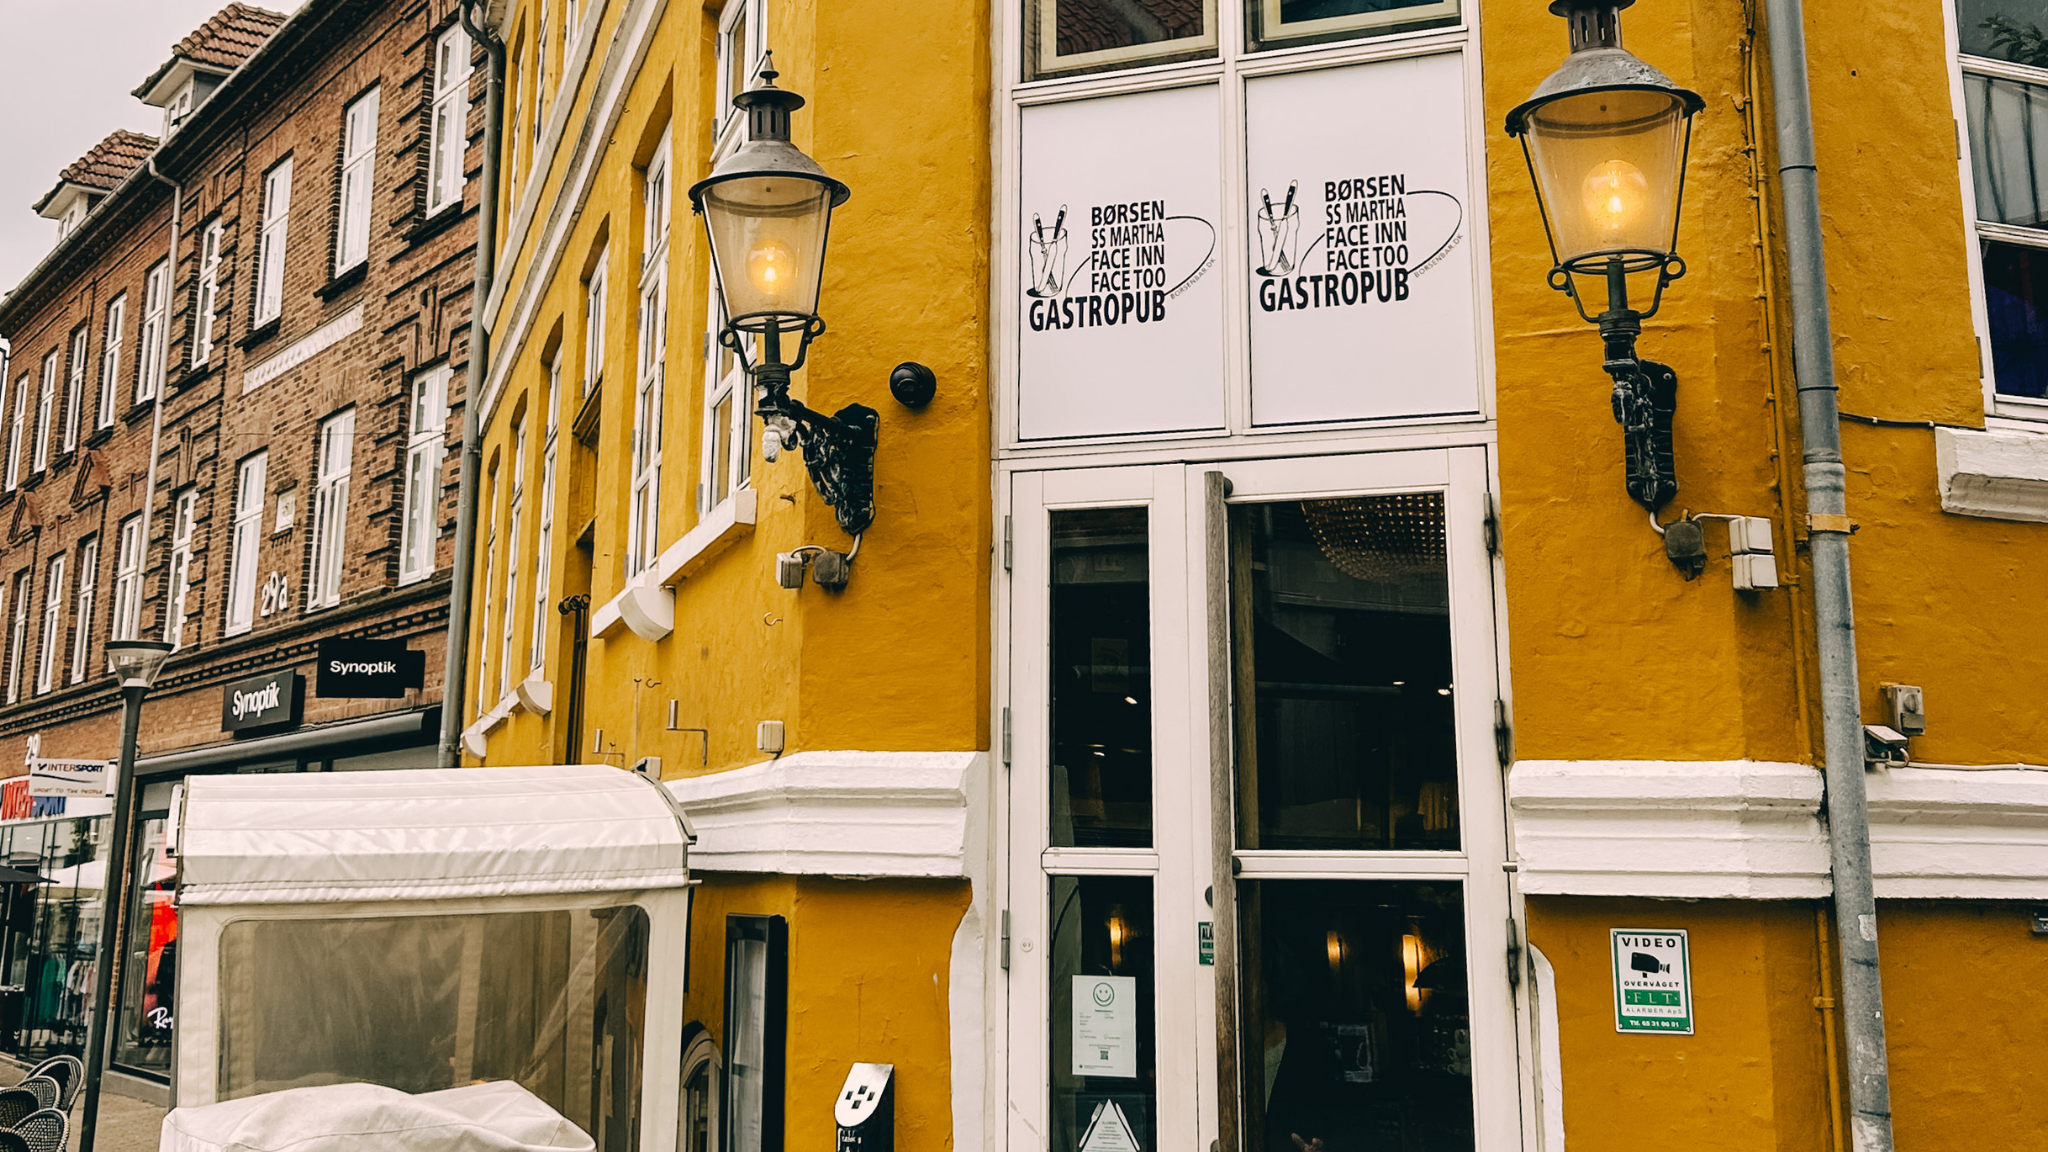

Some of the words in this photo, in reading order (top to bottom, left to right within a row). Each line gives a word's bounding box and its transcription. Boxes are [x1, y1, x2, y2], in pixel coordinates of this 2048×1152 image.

[1325, 174, 1405, 202] BØRSEN
[1091, 200, 1165, 226] BØRSEN
[1326, 203, 1342, 225] SS
[1346, 197, 1406, 223] MARTHA
[1091, 228, 1106, 249] SS
[1110, 222, 1165, 247] MARTHA
[1326, 224, 1369, 248] FACE
[1375, 220, 1407, 244] INN
[1091, 248, 1130, 271] FACE
[1136, 244, 1165, 266] INN
[1327, 247, 1370, 272] FACE
[1373, 244, 1409, 267] TOO
[1091, 270, 1131, 293] FACE
[1133, 267, 1166, 289] TOO
[1259, 267, 1410, 313] GASTROPUB
[1029, 290, 1166, 332] GASTROPUB
[260, 571, 289, 617] 29a
[330, 660, 397, 675] Synoptik
[232, 681, 281, 721] Synoptik
[47, 763, 104, 772] INTERSPORT
[1621, 937, 1676, 948] VIDEO
[1624, 980, 1680, 988] OVERVÅGET
